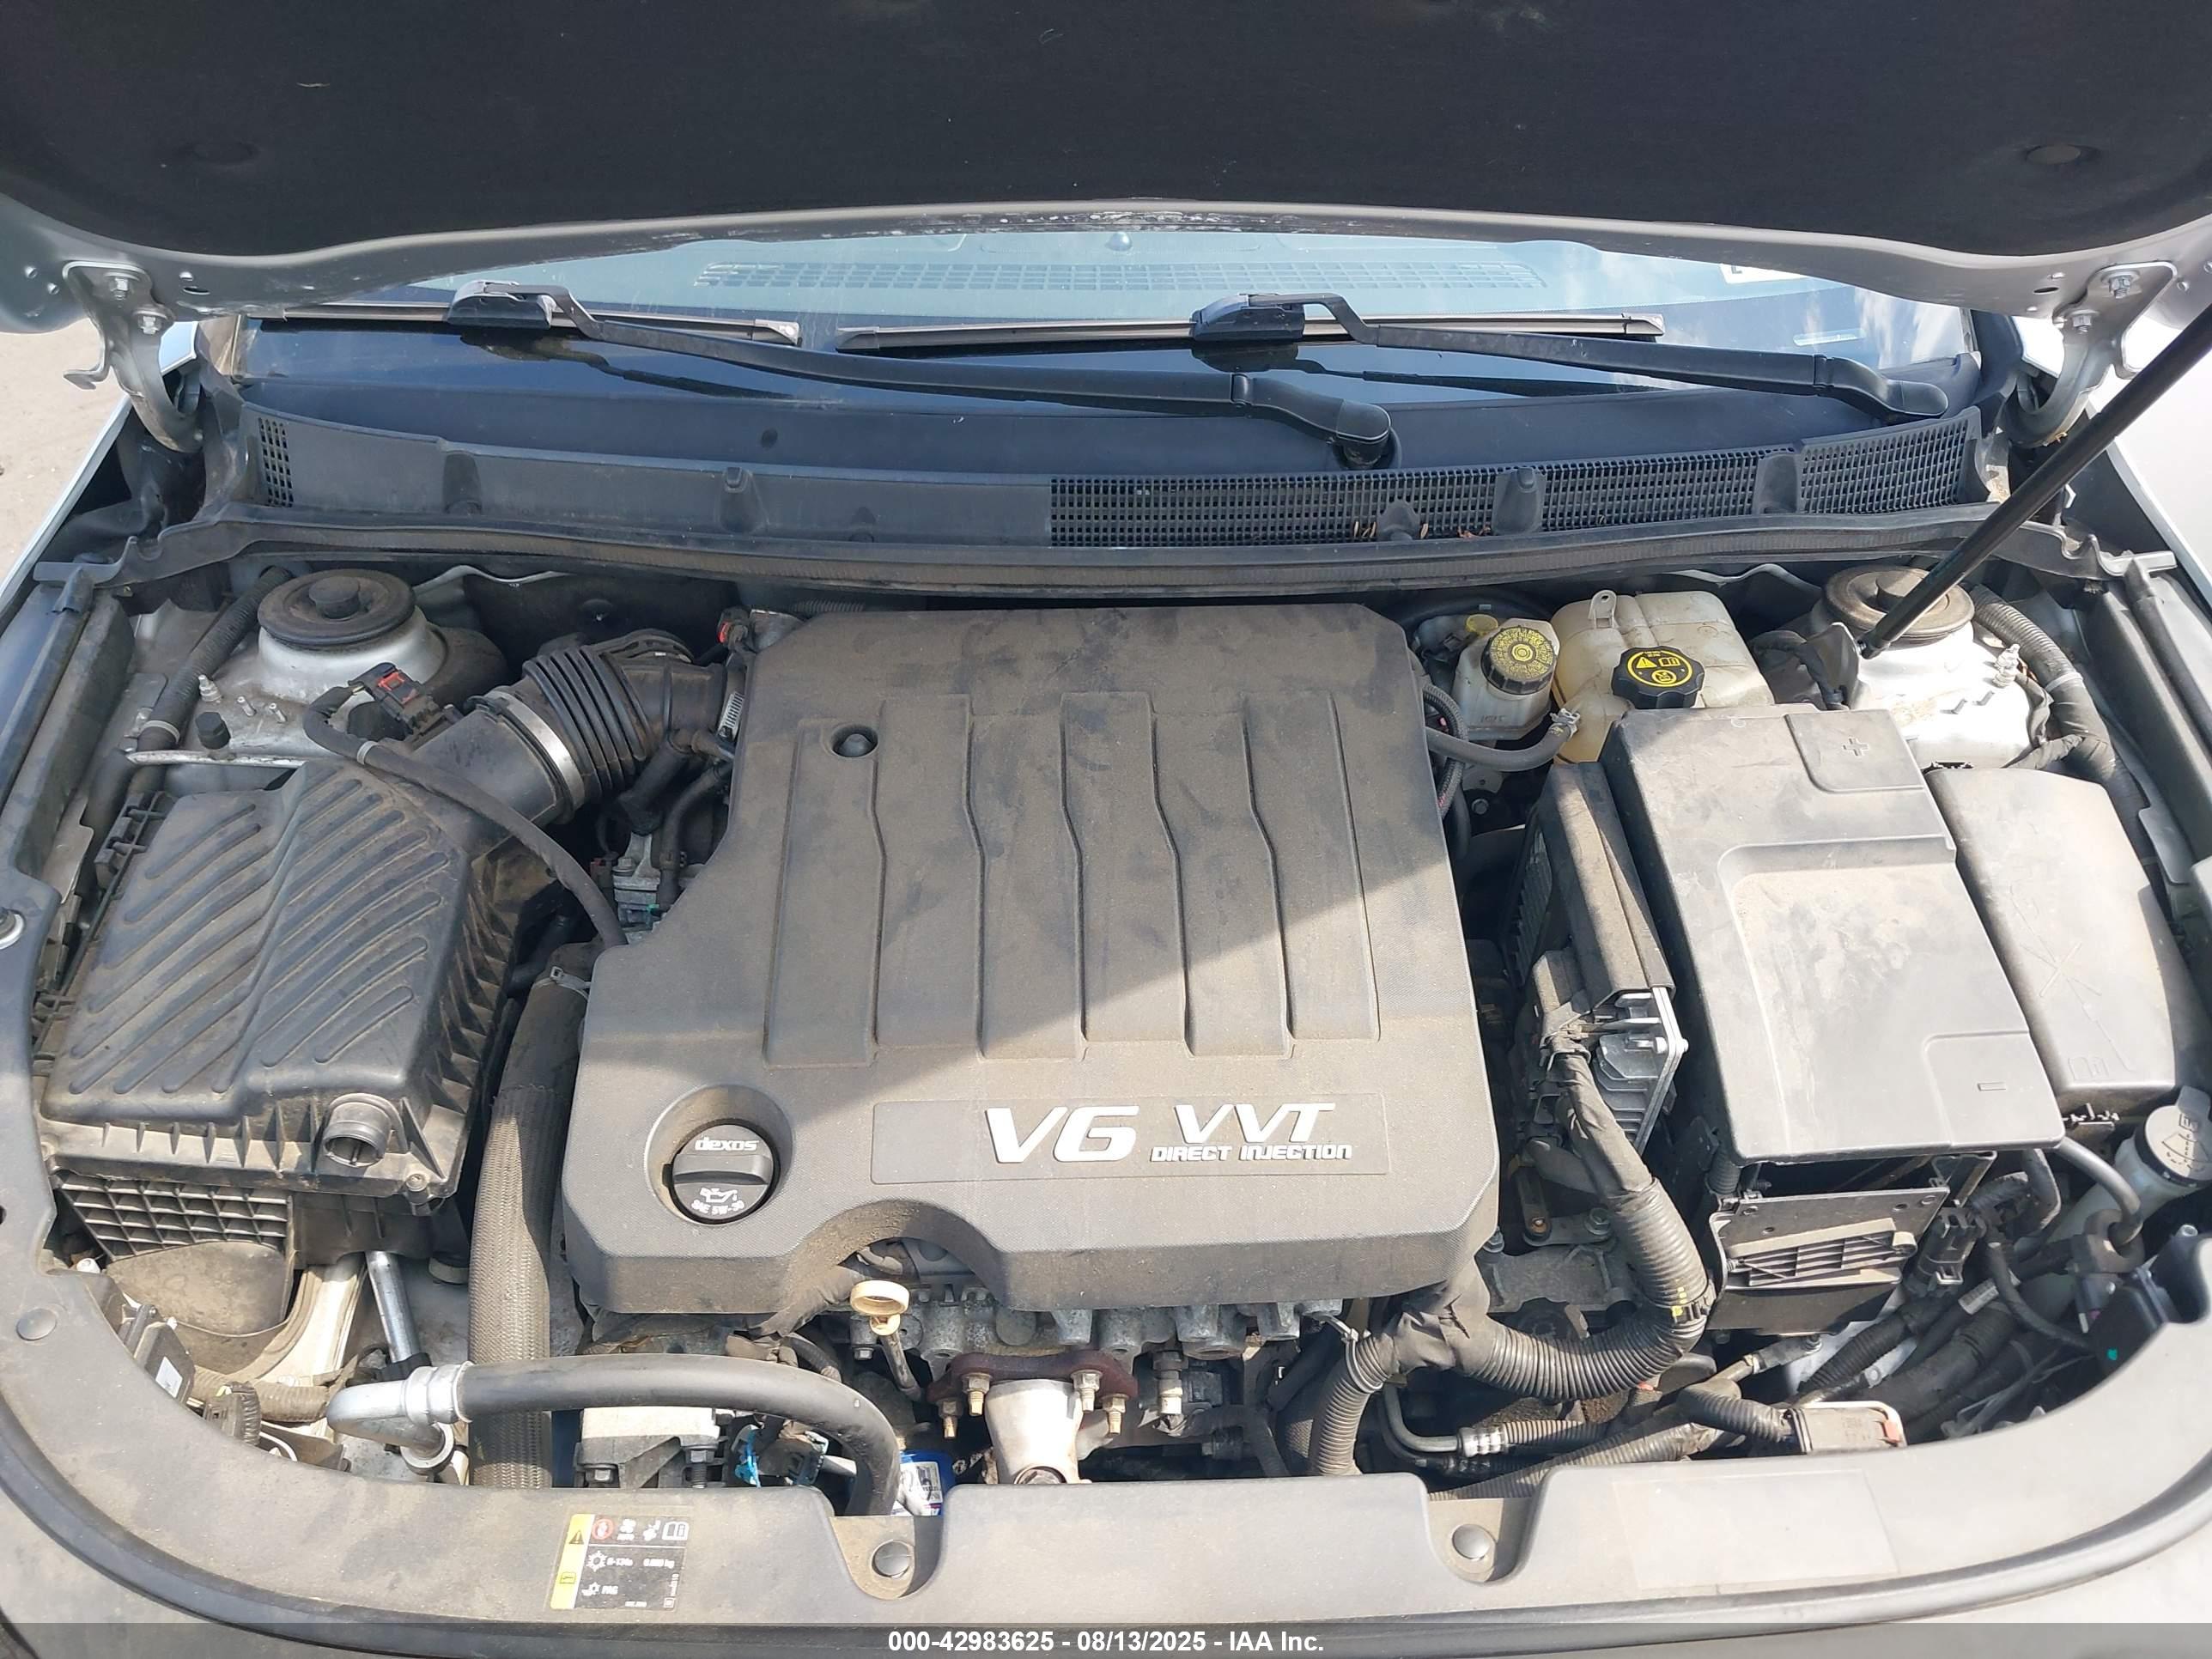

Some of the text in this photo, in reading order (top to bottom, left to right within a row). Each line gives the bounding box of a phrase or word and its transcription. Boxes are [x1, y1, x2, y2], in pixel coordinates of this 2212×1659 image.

[985, 1102, 1336, 1163] V6 VVT
[694, 1136, 759, 1152] dexos
[1150, 1144, 1353, 1162] DIRECT INJECTION
